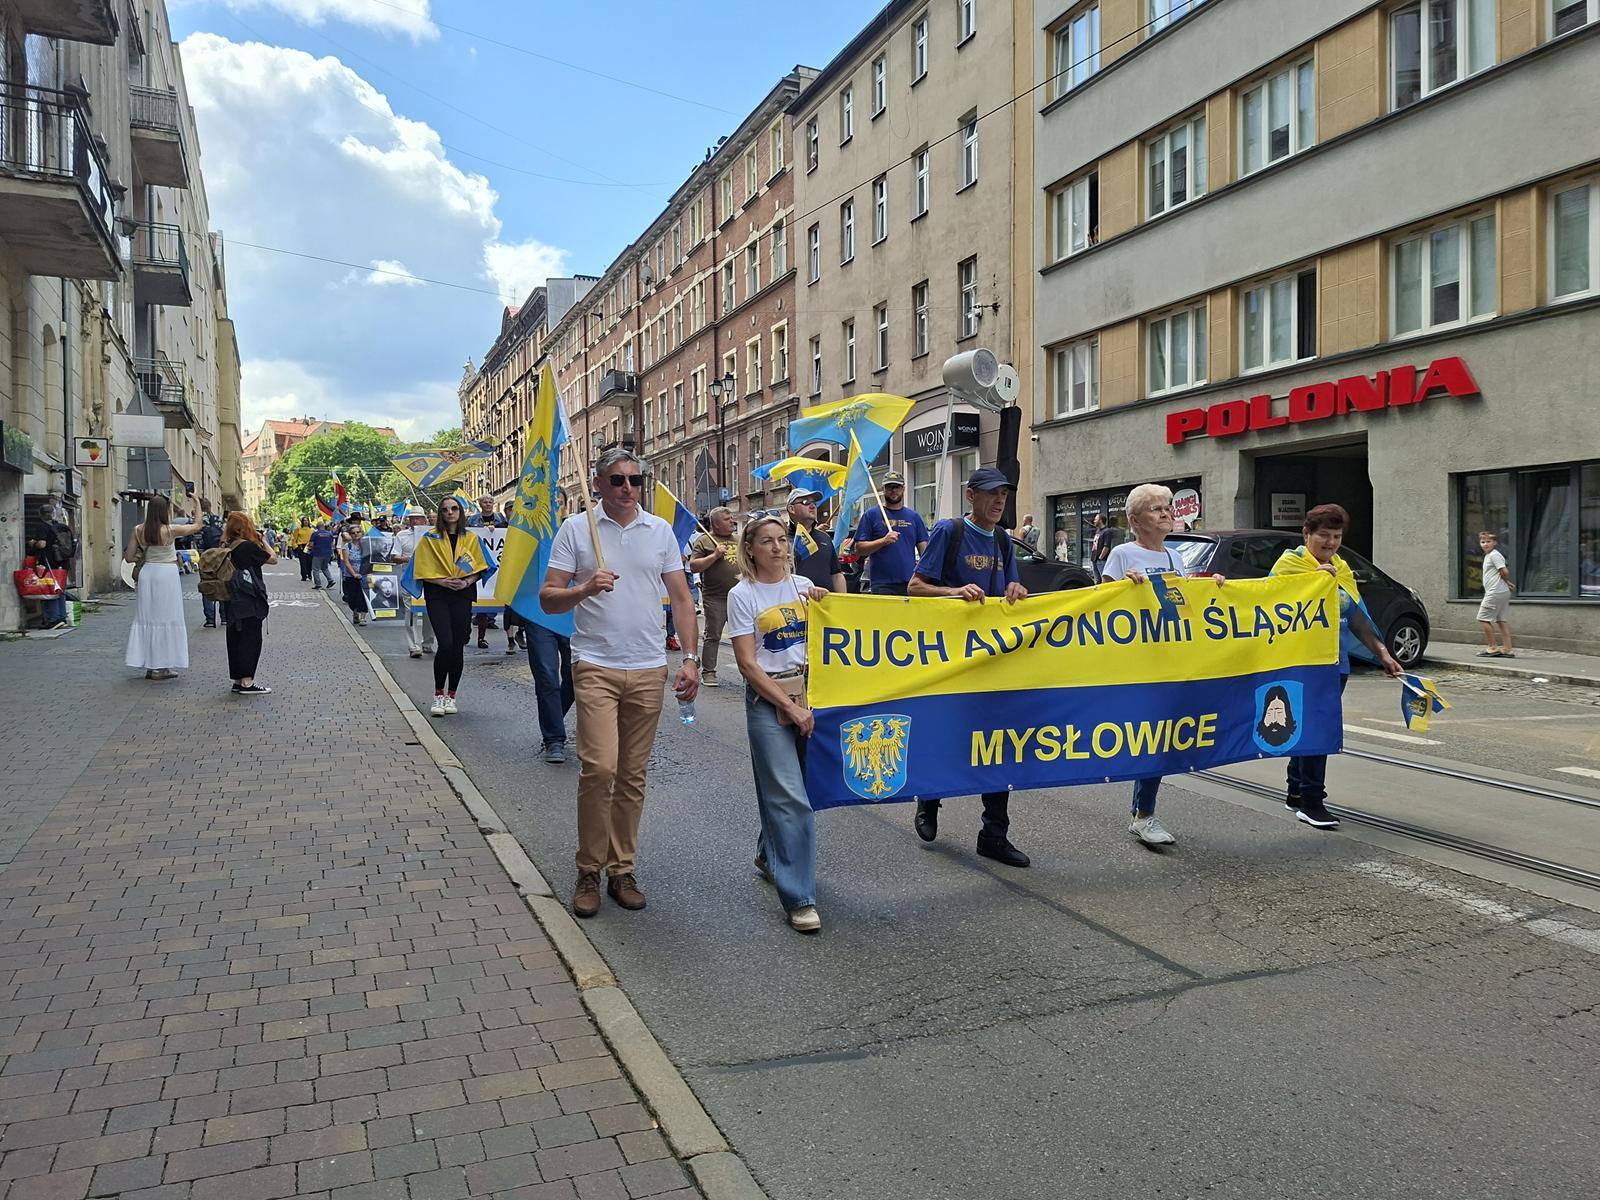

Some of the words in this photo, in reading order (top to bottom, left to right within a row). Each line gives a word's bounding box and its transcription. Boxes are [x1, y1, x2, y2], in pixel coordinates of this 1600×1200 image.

[1166, 356, 1481, 445] POLONIA
[917, 429, 952, 448] WOJN
[822, 626, 949, 667] RUCH
[964, 607, 1192, 659] AUTONOMII
[1203, 598, 1329, 644] ŚLĄSKA
[971, 713, 1217, 766] MYSŁOWICE
